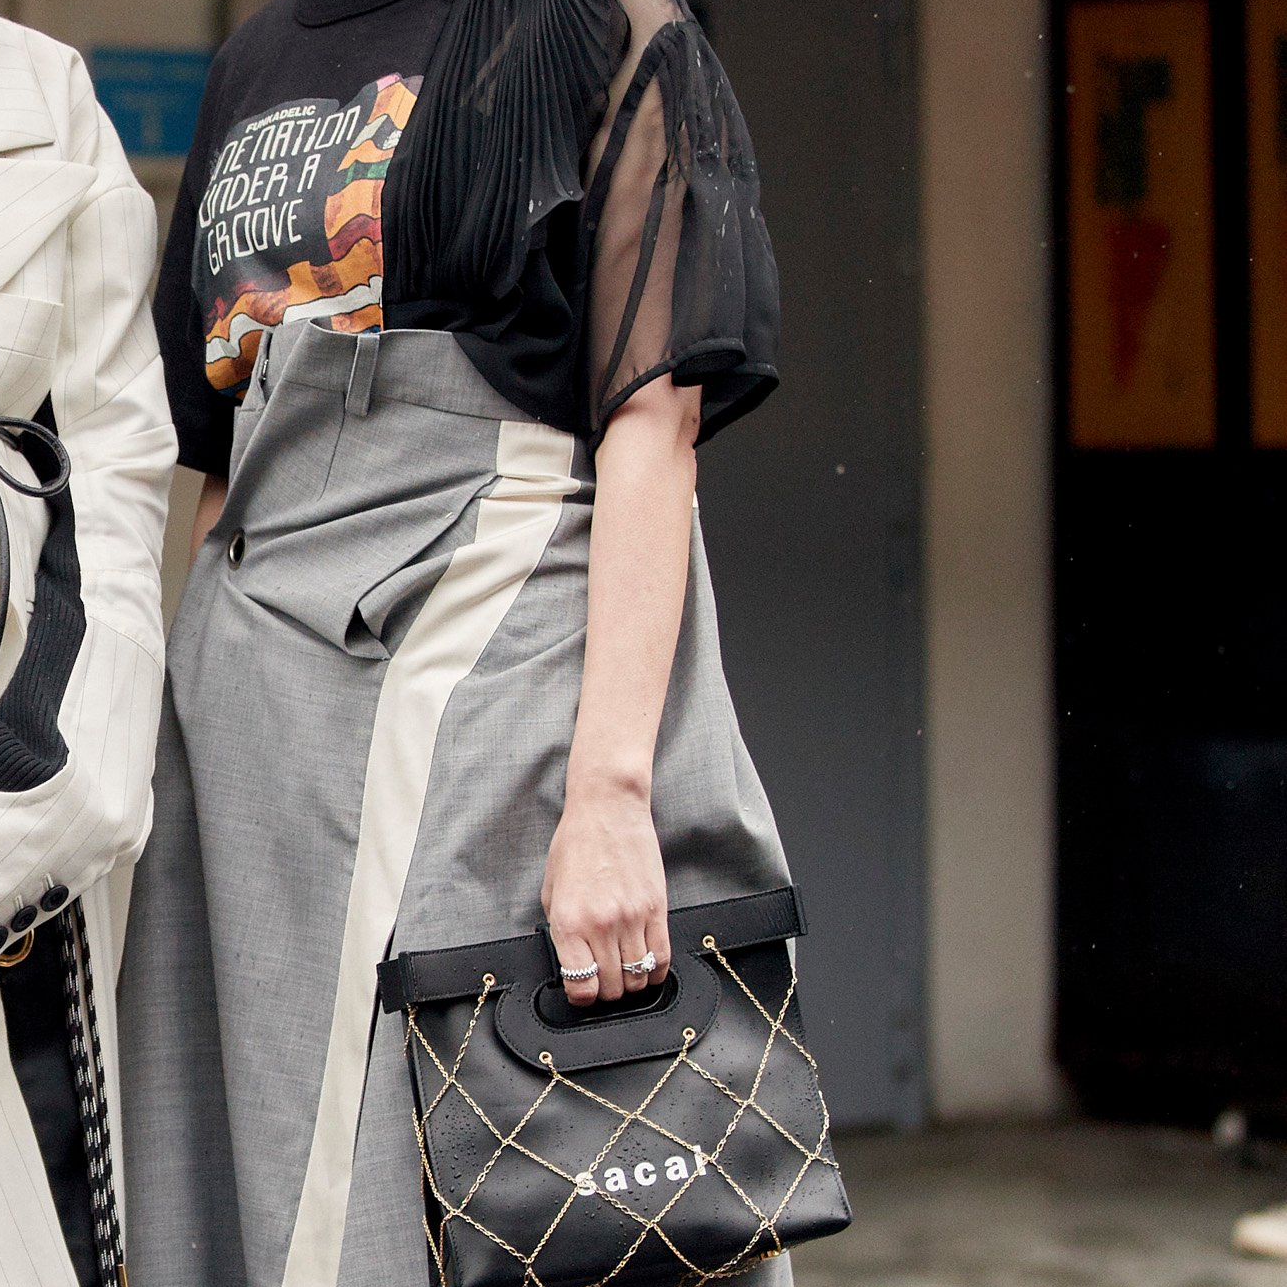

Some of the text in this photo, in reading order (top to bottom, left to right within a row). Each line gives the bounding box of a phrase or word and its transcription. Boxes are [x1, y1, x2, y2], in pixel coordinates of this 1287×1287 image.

[208, 105, 361, 187] NE NATION
[245, 105, 316, 133] FUNKADELIC
[199, 154, 321, 228] UNDER A
[208, 199, 303, 276] GROOVE
